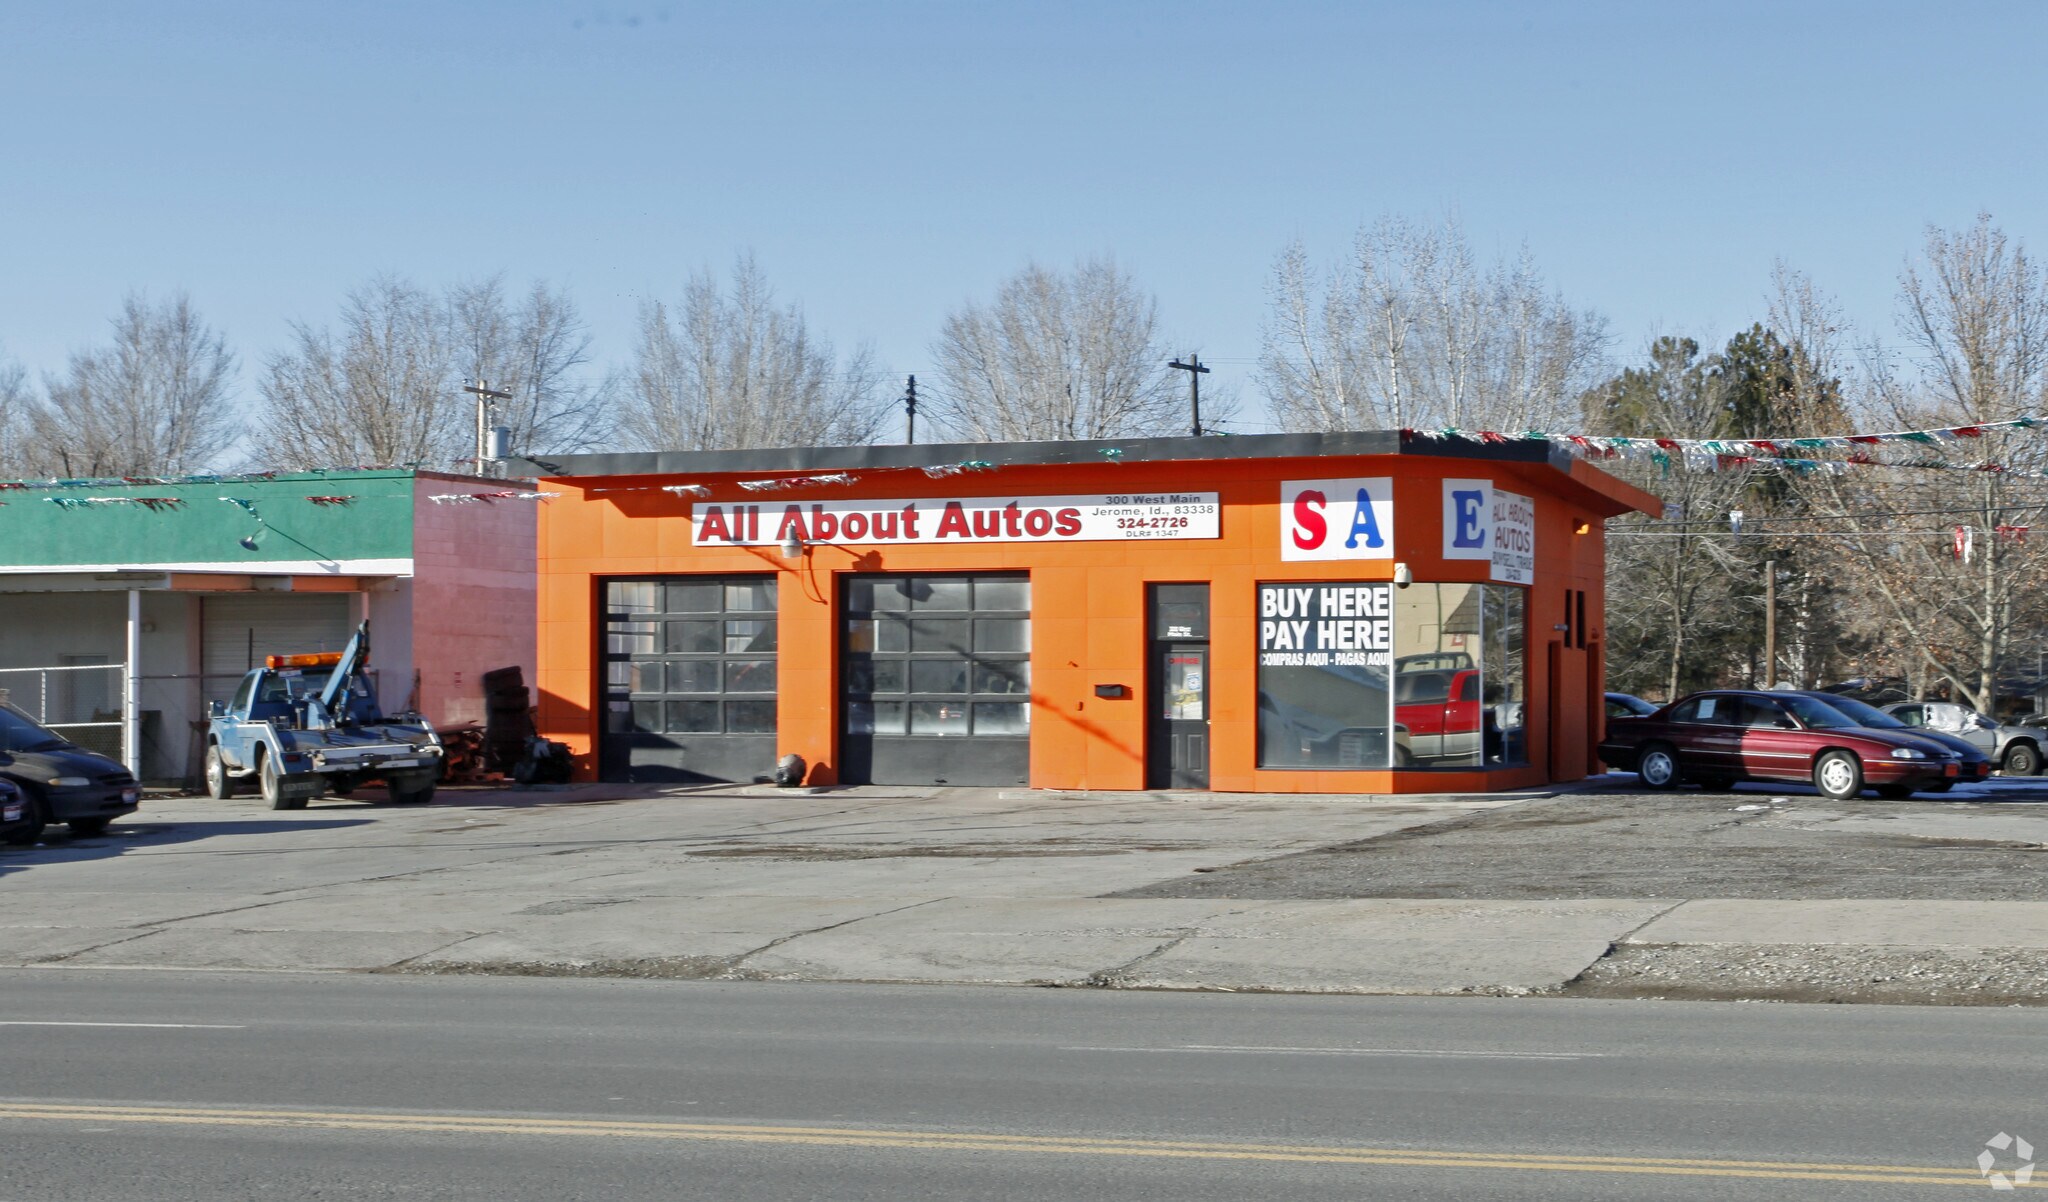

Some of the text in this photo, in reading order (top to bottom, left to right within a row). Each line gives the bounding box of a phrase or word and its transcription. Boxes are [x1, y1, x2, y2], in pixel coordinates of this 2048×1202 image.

[1105, 494, 1201, 505] 300 West Main
[1092, 505, 1214, 516] Jerome, Id., 83338
[1452, 490, 1485, 549] E
[697, 500, 1082, 542] All About Autos
[1117, 517, 1188, 528] 324-2726
[1156, 529, 1179, 537] 1347
[1495, 526, 1530, 553] AUTOS
[1262, 587, 1389, 618] BUY HERE
[1261, 620, 1389, 650] PAY HERE
[1260, 653, 1304, 666] COMPRAS
[1304, 652, 1328, 666] AQUI
[1335, 652, 1366, 666] PAGAS
